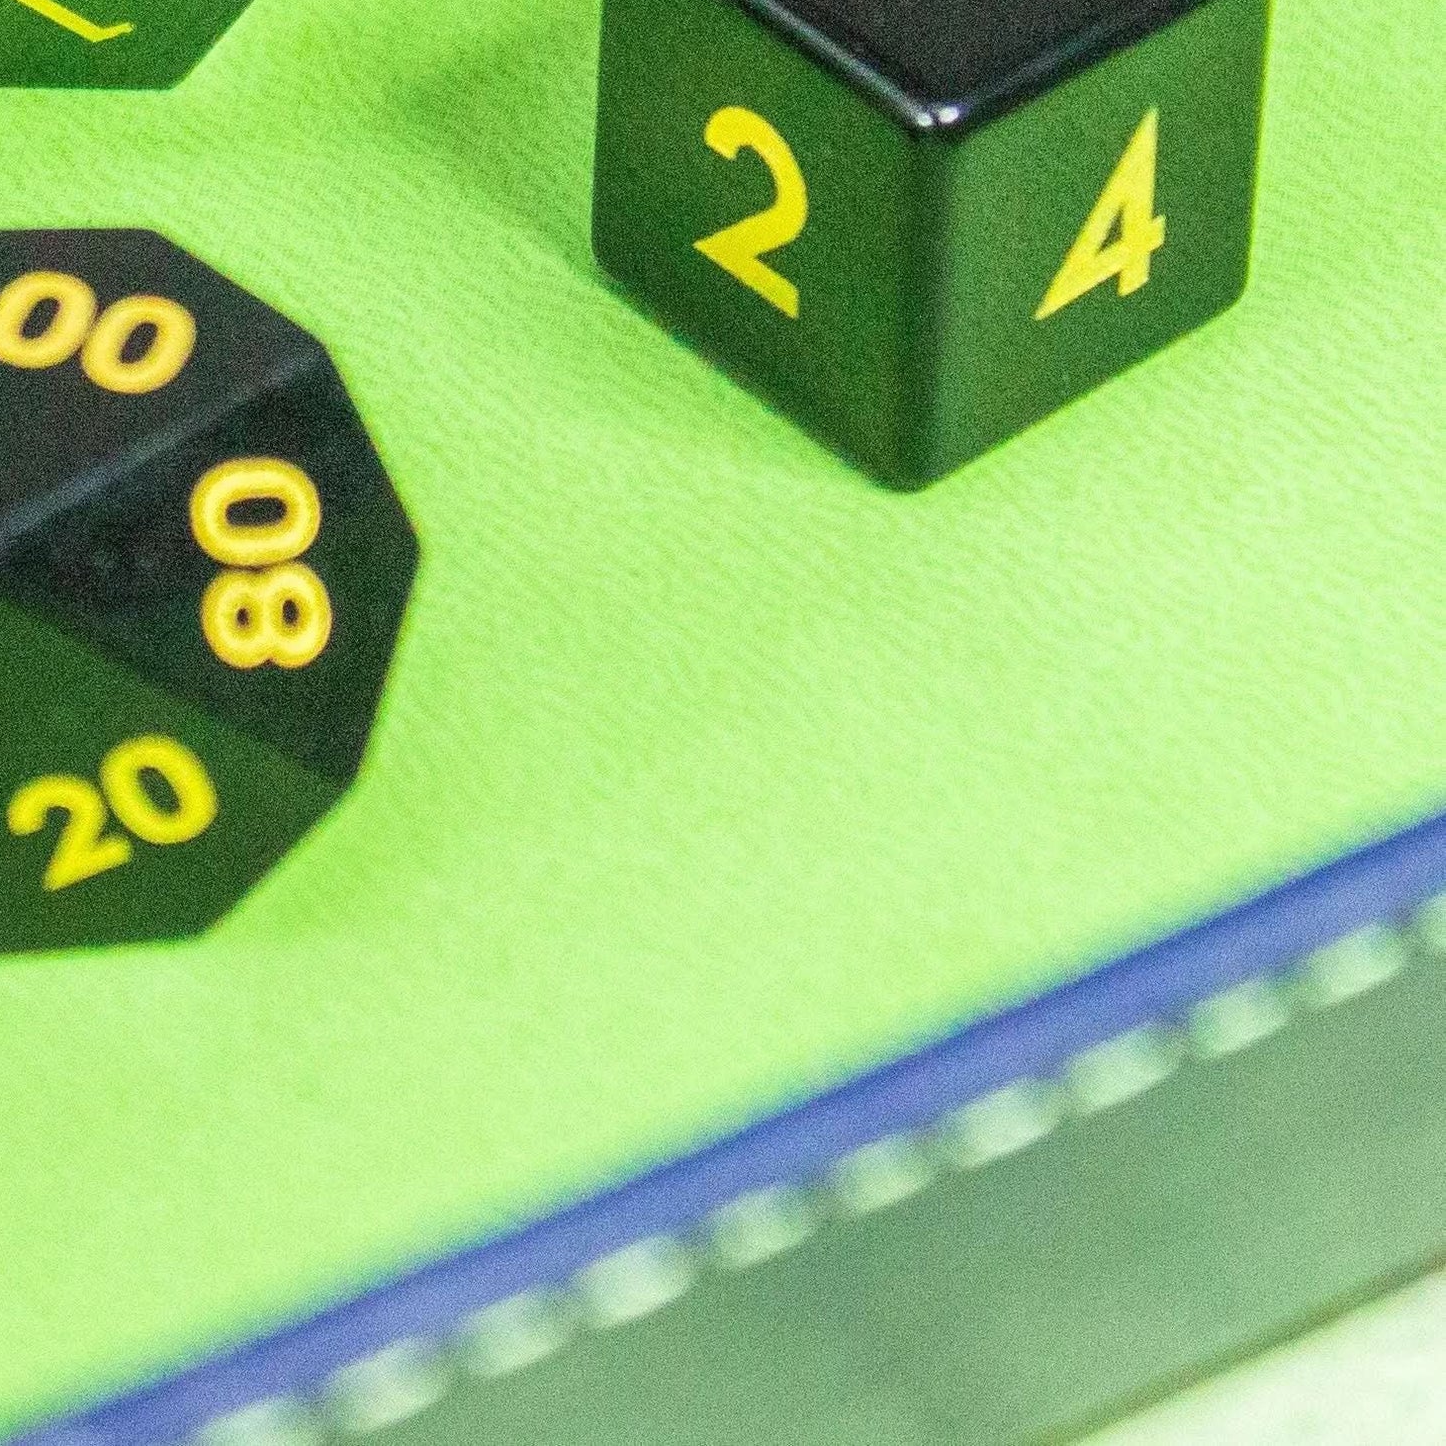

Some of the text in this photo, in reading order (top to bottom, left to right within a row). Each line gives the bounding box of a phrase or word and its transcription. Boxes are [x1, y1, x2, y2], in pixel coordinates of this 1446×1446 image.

[692, 104, 809, 320] 2
[1034, 104, 1166, 321] 4
[187, 456, 334, 671] 80
[5, 734, 219, 892] 20
